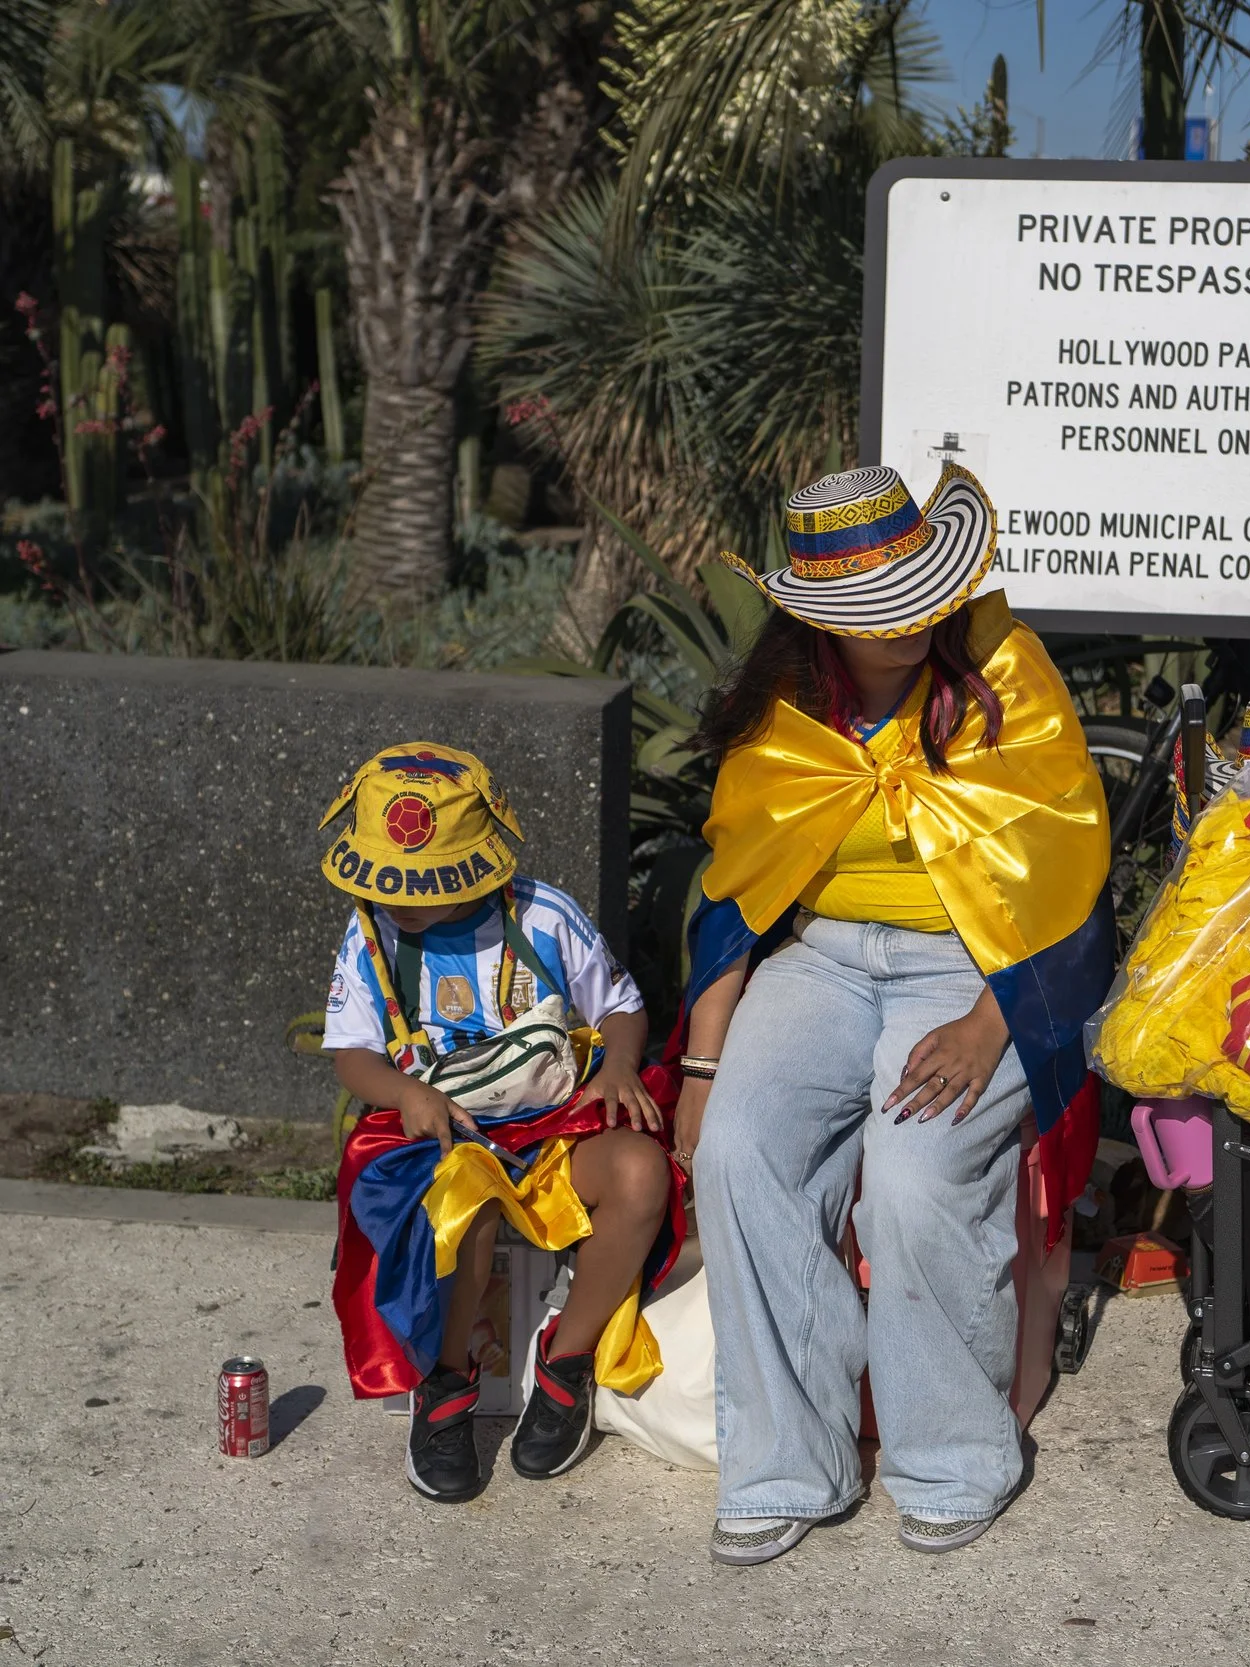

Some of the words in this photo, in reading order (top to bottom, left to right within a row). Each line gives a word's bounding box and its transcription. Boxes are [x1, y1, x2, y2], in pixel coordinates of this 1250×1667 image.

[1018, 214, 1156, 245] PRIVATE
[1039, 262, 1081, 292] NO
[1058, 338, 1209, 368] HOLLYWOOD
[1006, 380, 1120, 409] PATRONS
[1128, 383, 1177, 410] AND
[1061, 425, 1208, 454] PERSONNEL
[995, 509, 1091, 537] LEWOOD
[1100, 512, 1233, 541] MUNICIPAL
[989, 547, 1120, 576] ALIFORNIA
[1129, 551, 1209, 579] PENAL
[331, 840, 496, 896] COLOMBIA
